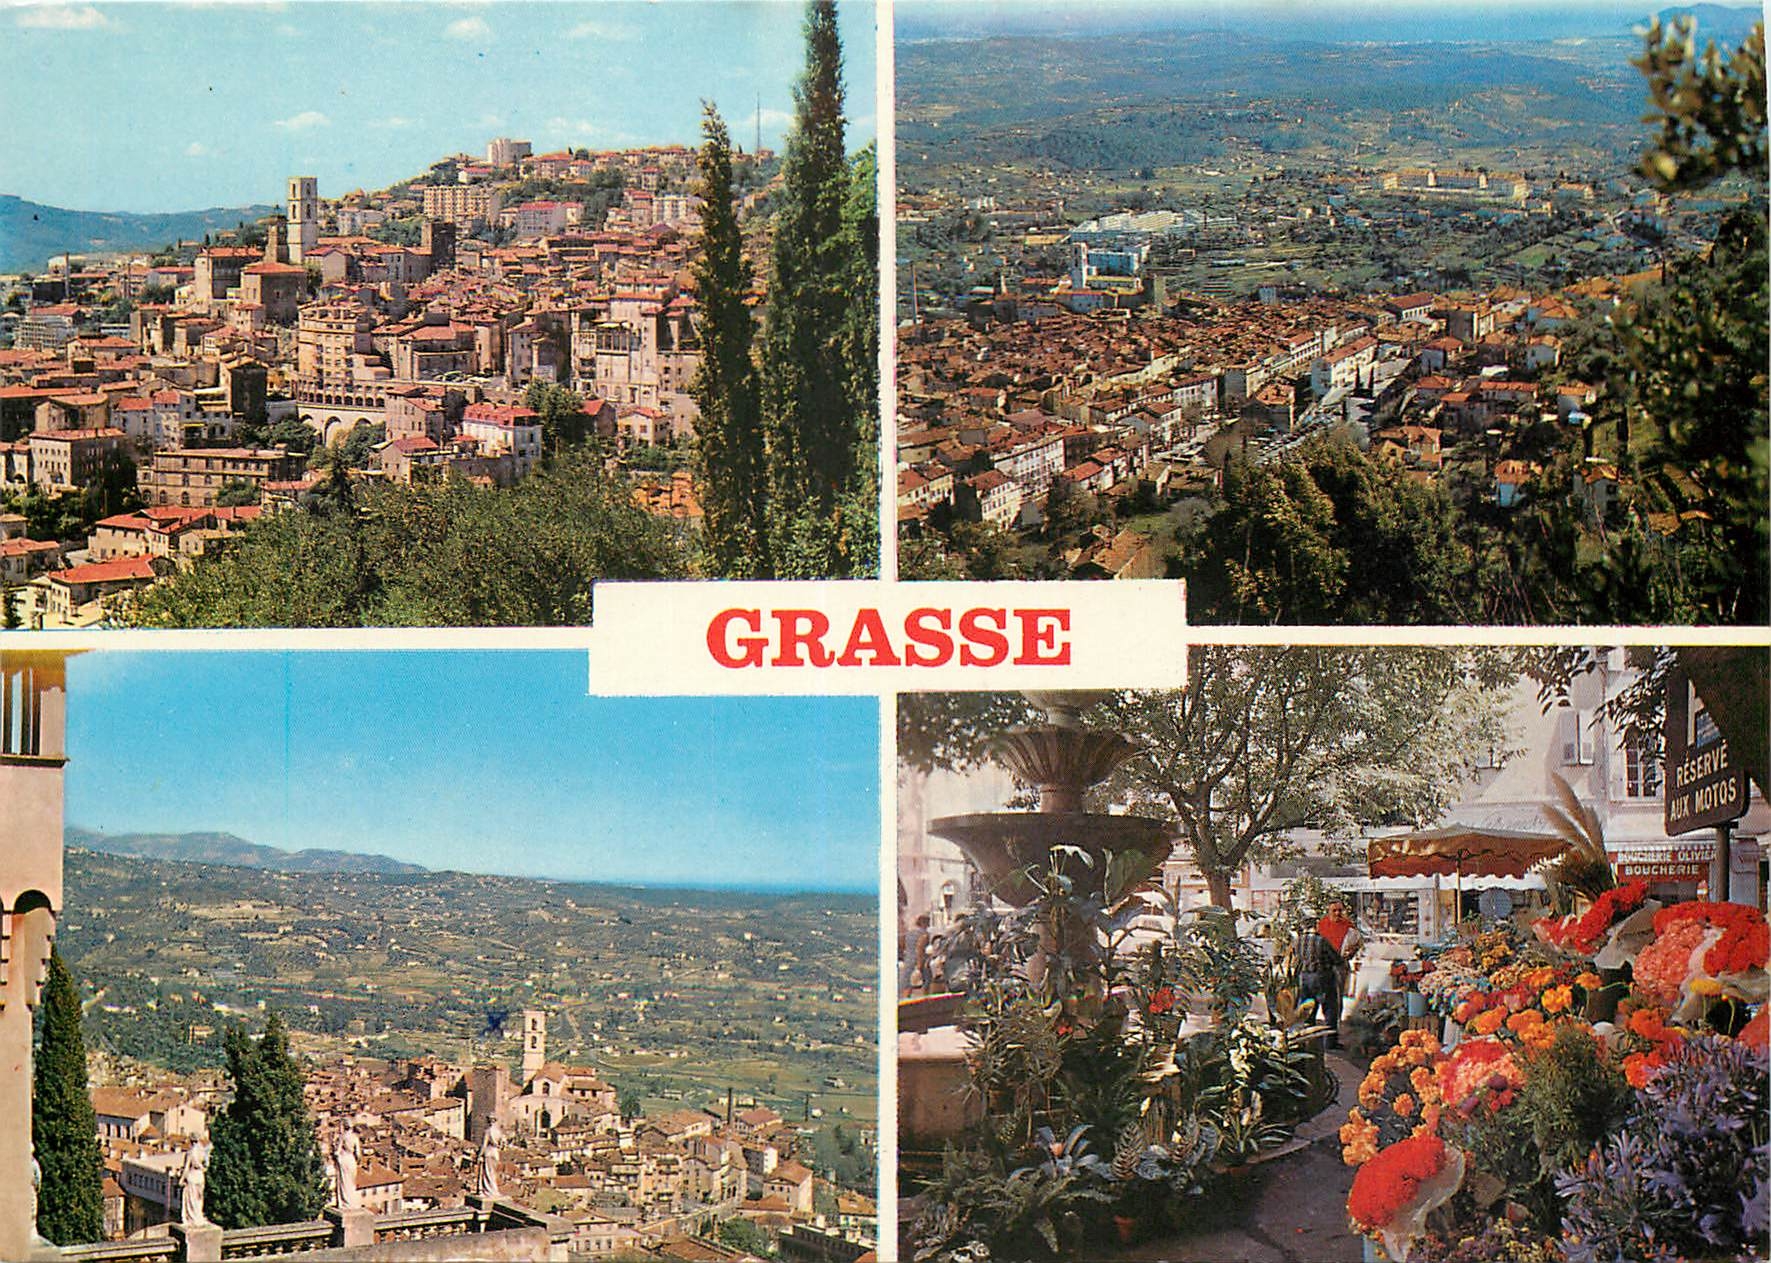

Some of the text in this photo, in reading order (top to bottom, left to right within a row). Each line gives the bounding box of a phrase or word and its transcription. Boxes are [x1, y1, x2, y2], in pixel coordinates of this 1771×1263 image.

[1676, 738, 1729, 788] RÉSERVÉ
[1670, 777, 1737, 820] AUX MOTOS
[1625, 864, 1699, 876] BOUCHERIE
